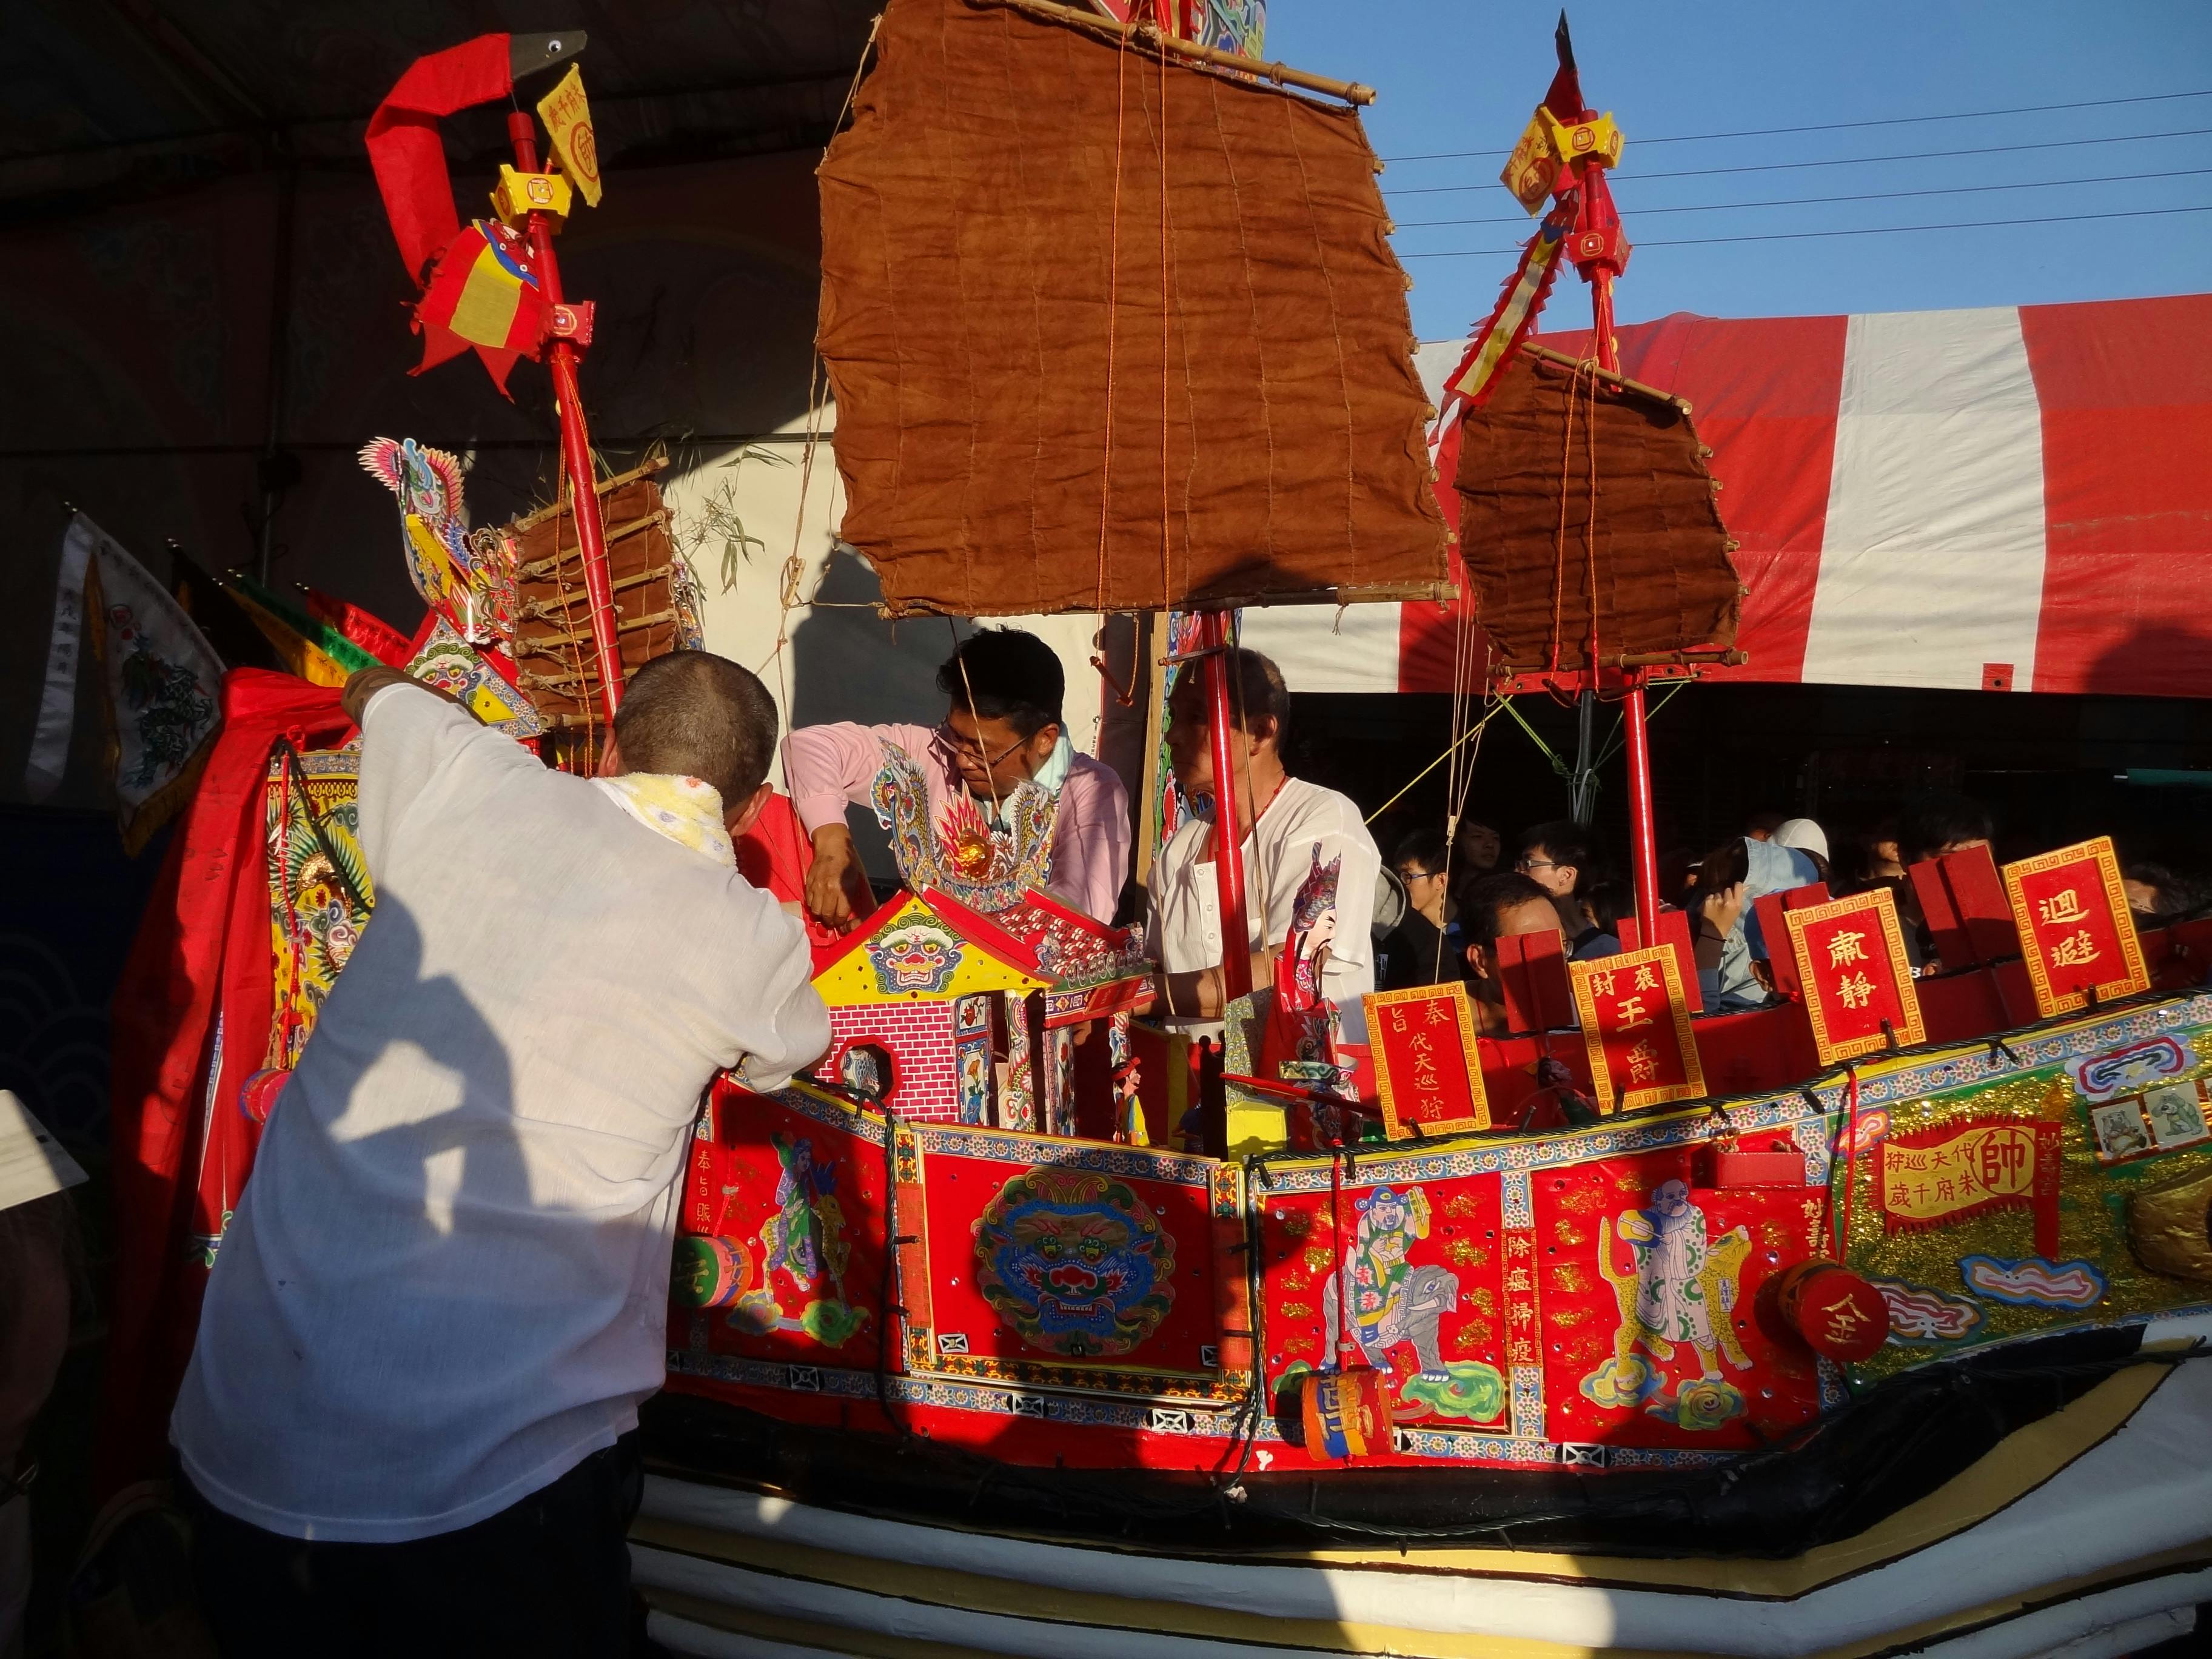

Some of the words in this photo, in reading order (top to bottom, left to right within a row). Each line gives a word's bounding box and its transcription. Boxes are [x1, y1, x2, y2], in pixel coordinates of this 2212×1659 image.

[1826, 930, 1877, 1010] 肅靜
[1409, 1032, 1444, 1119] 代天巡狩
[1980, 1131, 2026, 1190] 帥
[1507, 1236, 1535, 1363] 除瘟掃疫
